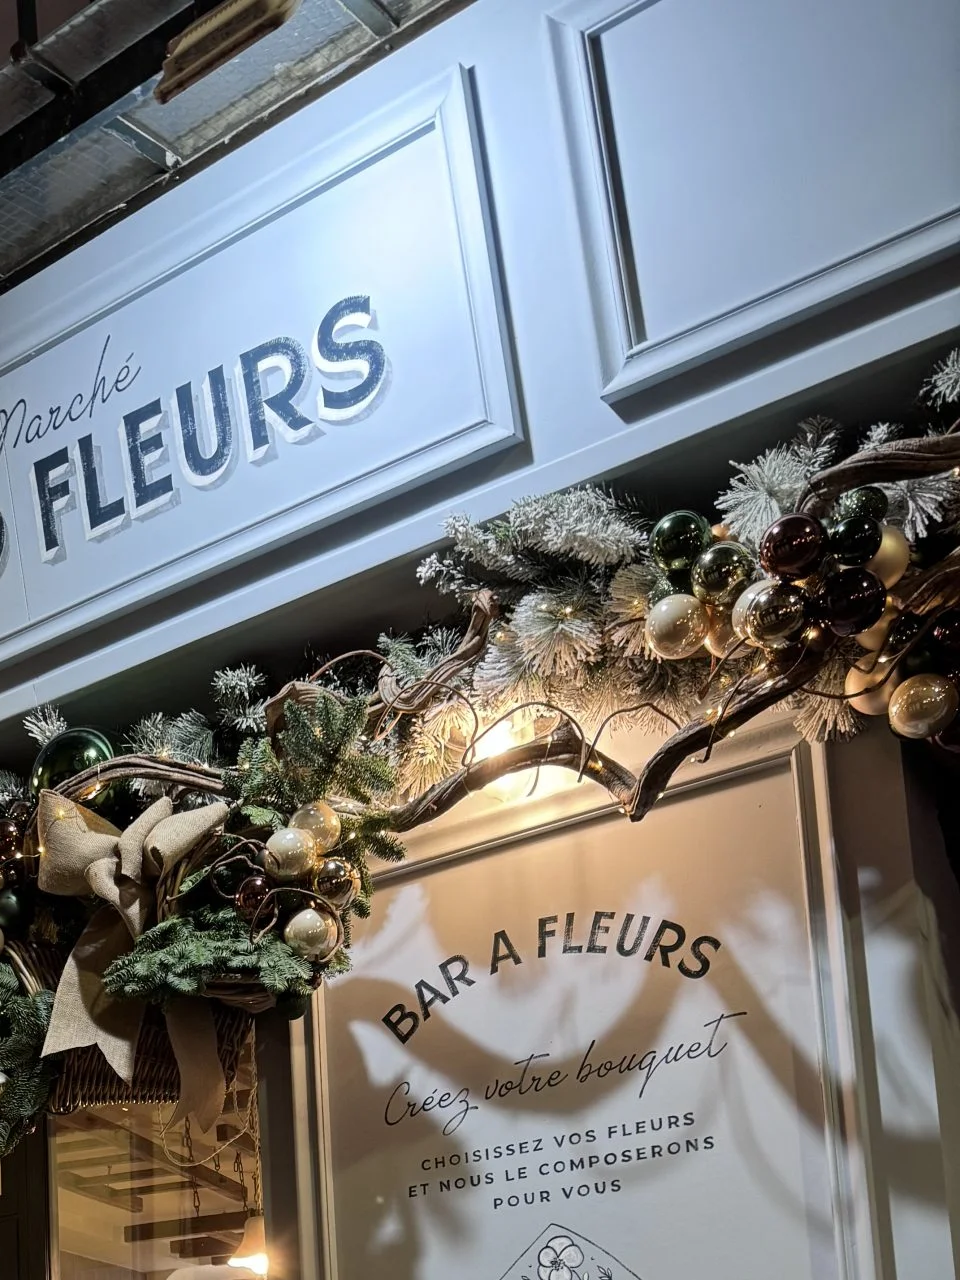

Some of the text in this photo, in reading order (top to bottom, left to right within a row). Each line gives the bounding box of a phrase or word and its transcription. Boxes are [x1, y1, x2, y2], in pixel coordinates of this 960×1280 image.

[32, 295, 389, 563] FLEURS
[381, 911, 722, 1045] BAR A FLEURS
[384, 1011, 748, 1136] Créez votre bouquet
[408, 1135, 716, 1199] ET NOUS LE COMPOSERONS
[421, 1111, 696, 1172] CHOISISSEZ VOS FLEURS
[493, 1179, 622, 1210] POUR VOUS
